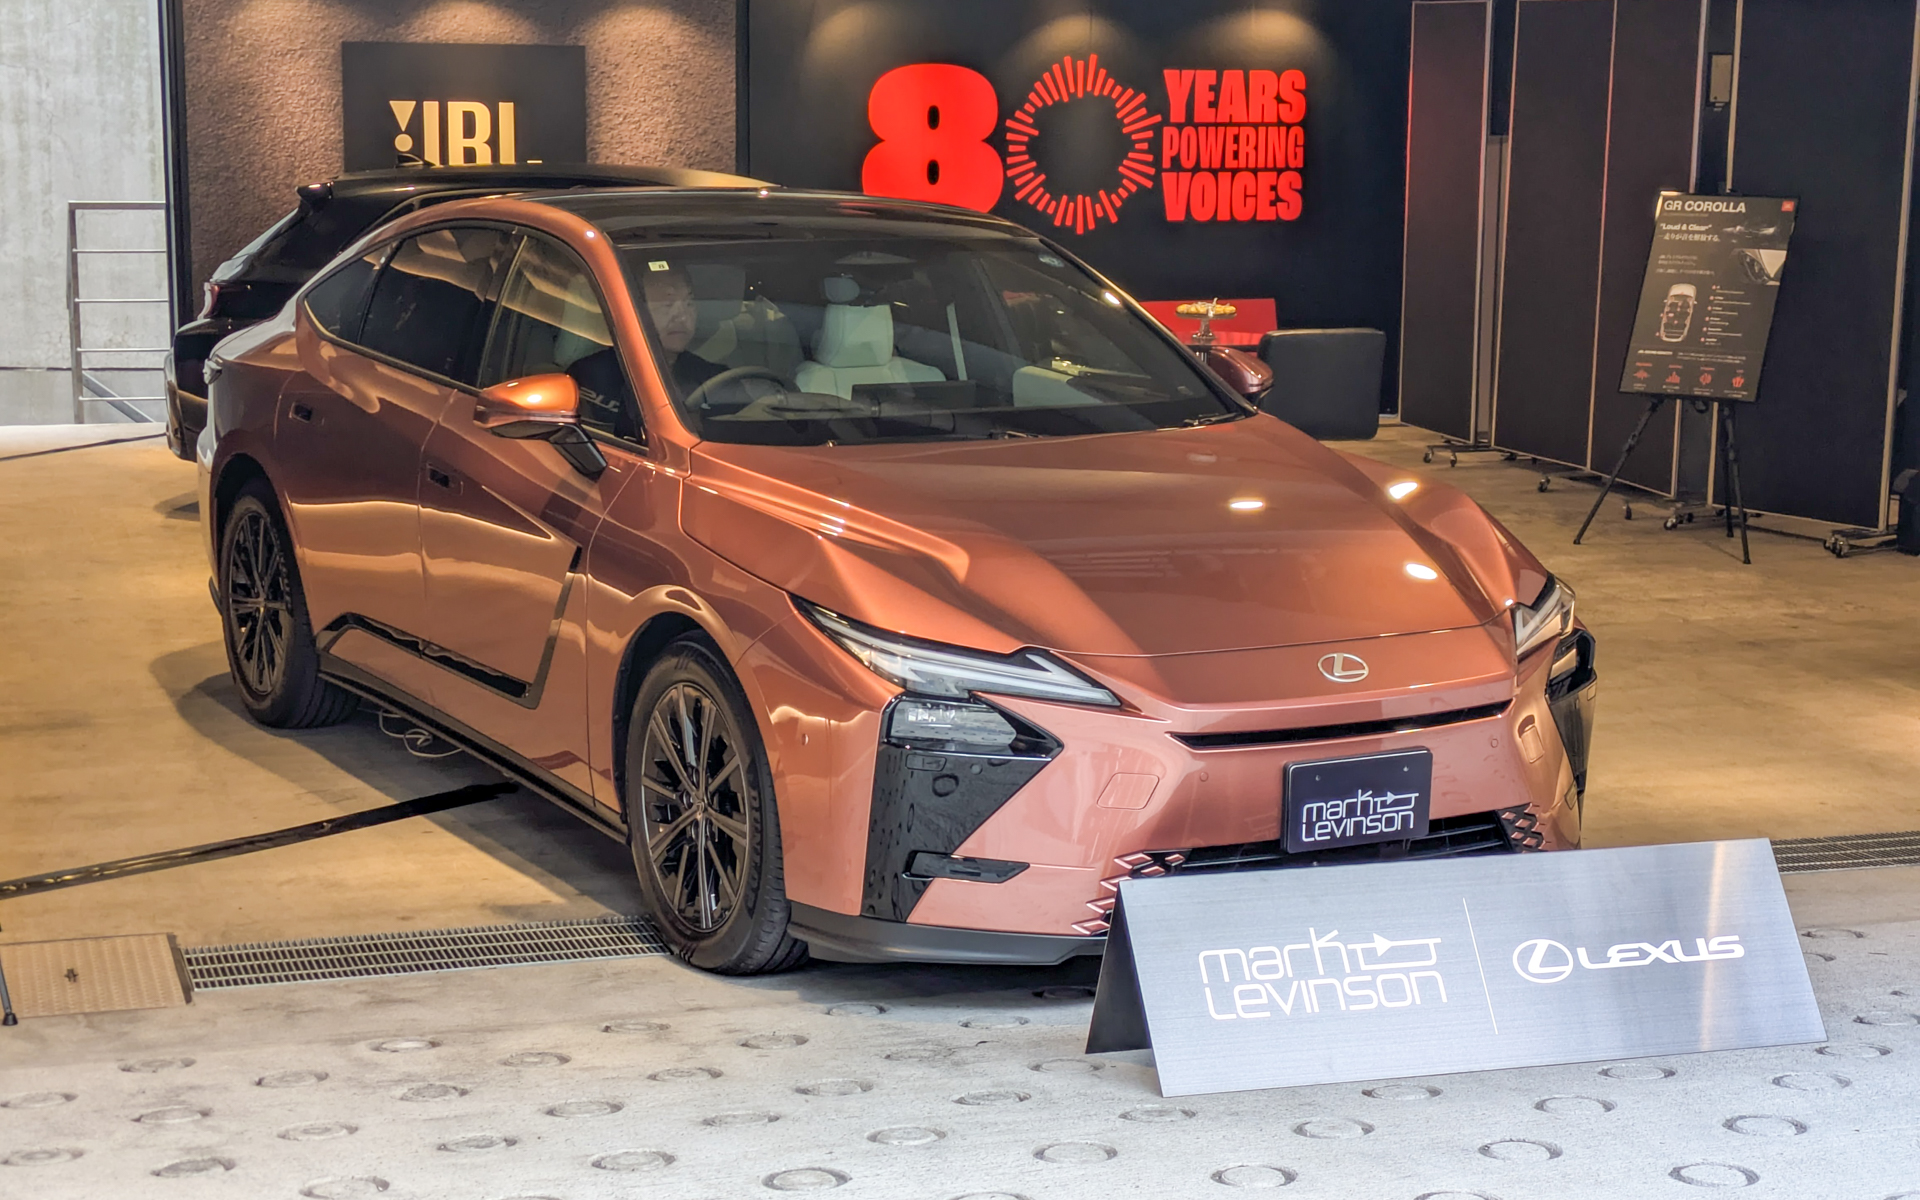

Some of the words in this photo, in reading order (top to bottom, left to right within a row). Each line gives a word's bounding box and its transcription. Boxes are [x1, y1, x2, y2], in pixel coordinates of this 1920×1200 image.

[1163, 69, 1306, 123] YEARS
[1162, 126, 1305, 168] POWERING
[1162, 171, 1304, 221] VOICES
[1664, 200, 1682, 211] GR
[1684, 201, 1746, 213] COROLLA
[1303, 789, 1374, 823] mark
[1199, 927, 1351, 984] mark
[1576, 935, 1745, 970] LEXUS
